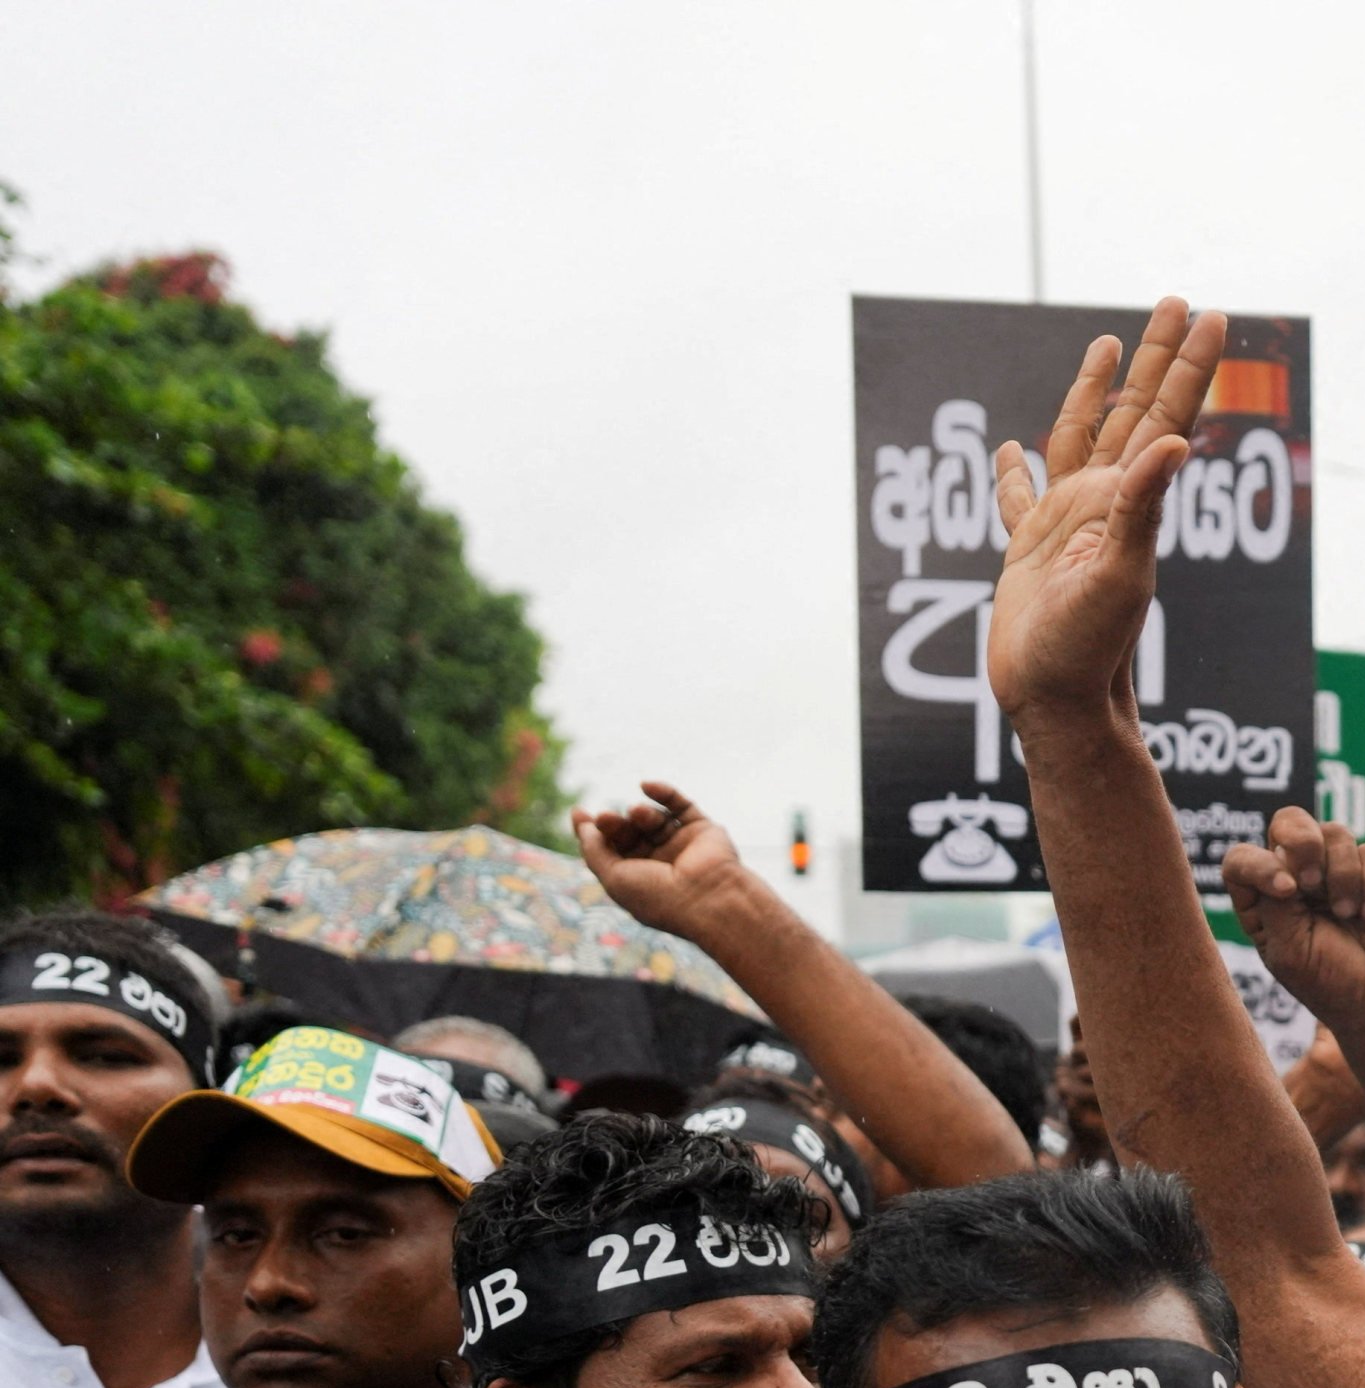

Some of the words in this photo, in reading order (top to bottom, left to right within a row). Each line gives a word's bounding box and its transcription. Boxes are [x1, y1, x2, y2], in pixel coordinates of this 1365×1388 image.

[32, 953, 110, 996] 22
[458, 1268, 528, 1357] JB
[588, 1223, 688, 1292] 22
